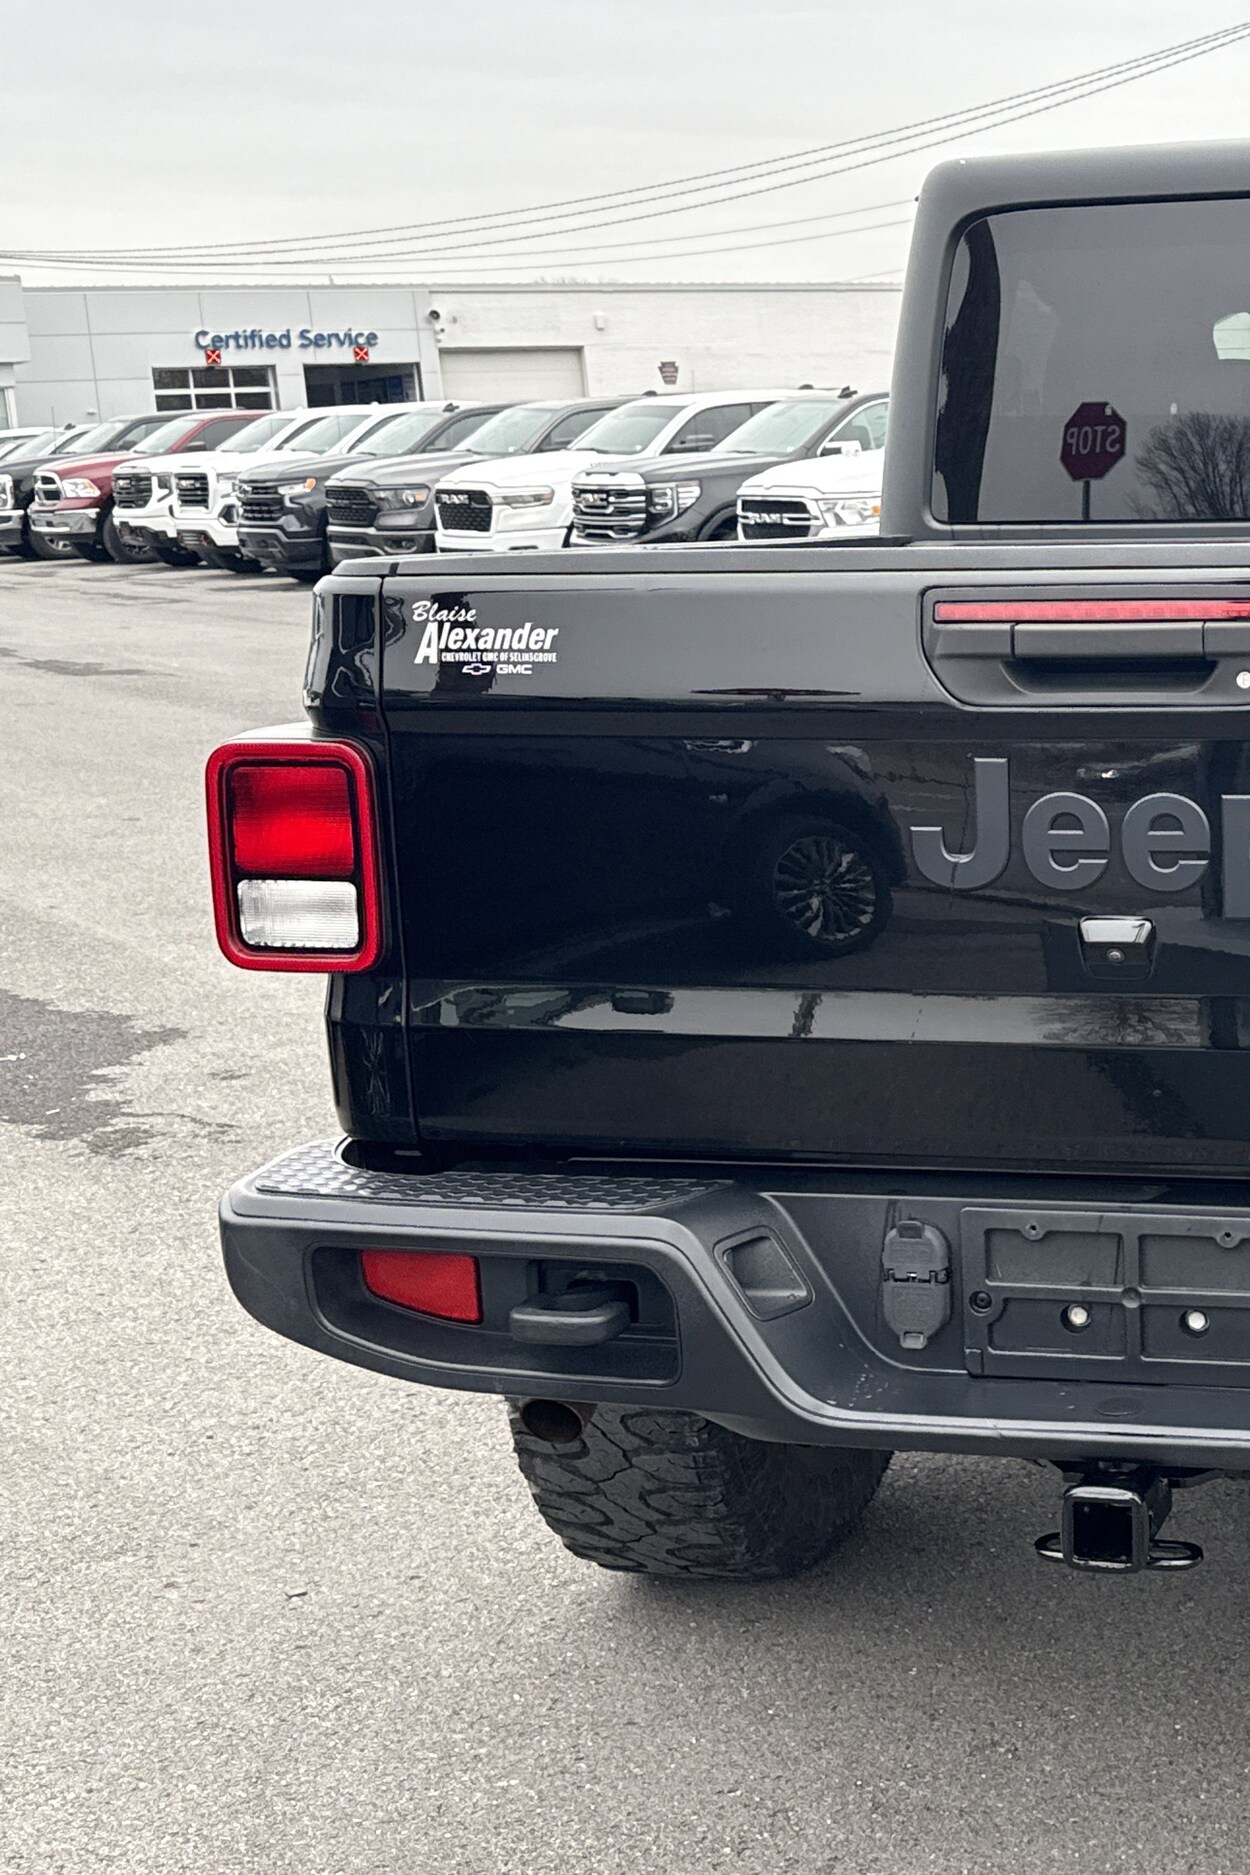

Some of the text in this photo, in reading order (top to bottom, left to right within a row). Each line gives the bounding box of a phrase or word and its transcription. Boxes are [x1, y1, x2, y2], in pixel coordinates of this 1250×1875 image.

[195, 328, 380, 350] Certified Service
[441, 494, 469, 504] RAM
[750, 513, 780, 524] RAM
[411, 600, 477, 622] Blaise
[414, 621, 559, 664] Alexander
[441, 652, 557, 662] CHEVROLET GMC OF SELINSGROVE
[496, 664, 533, 674] GMC
